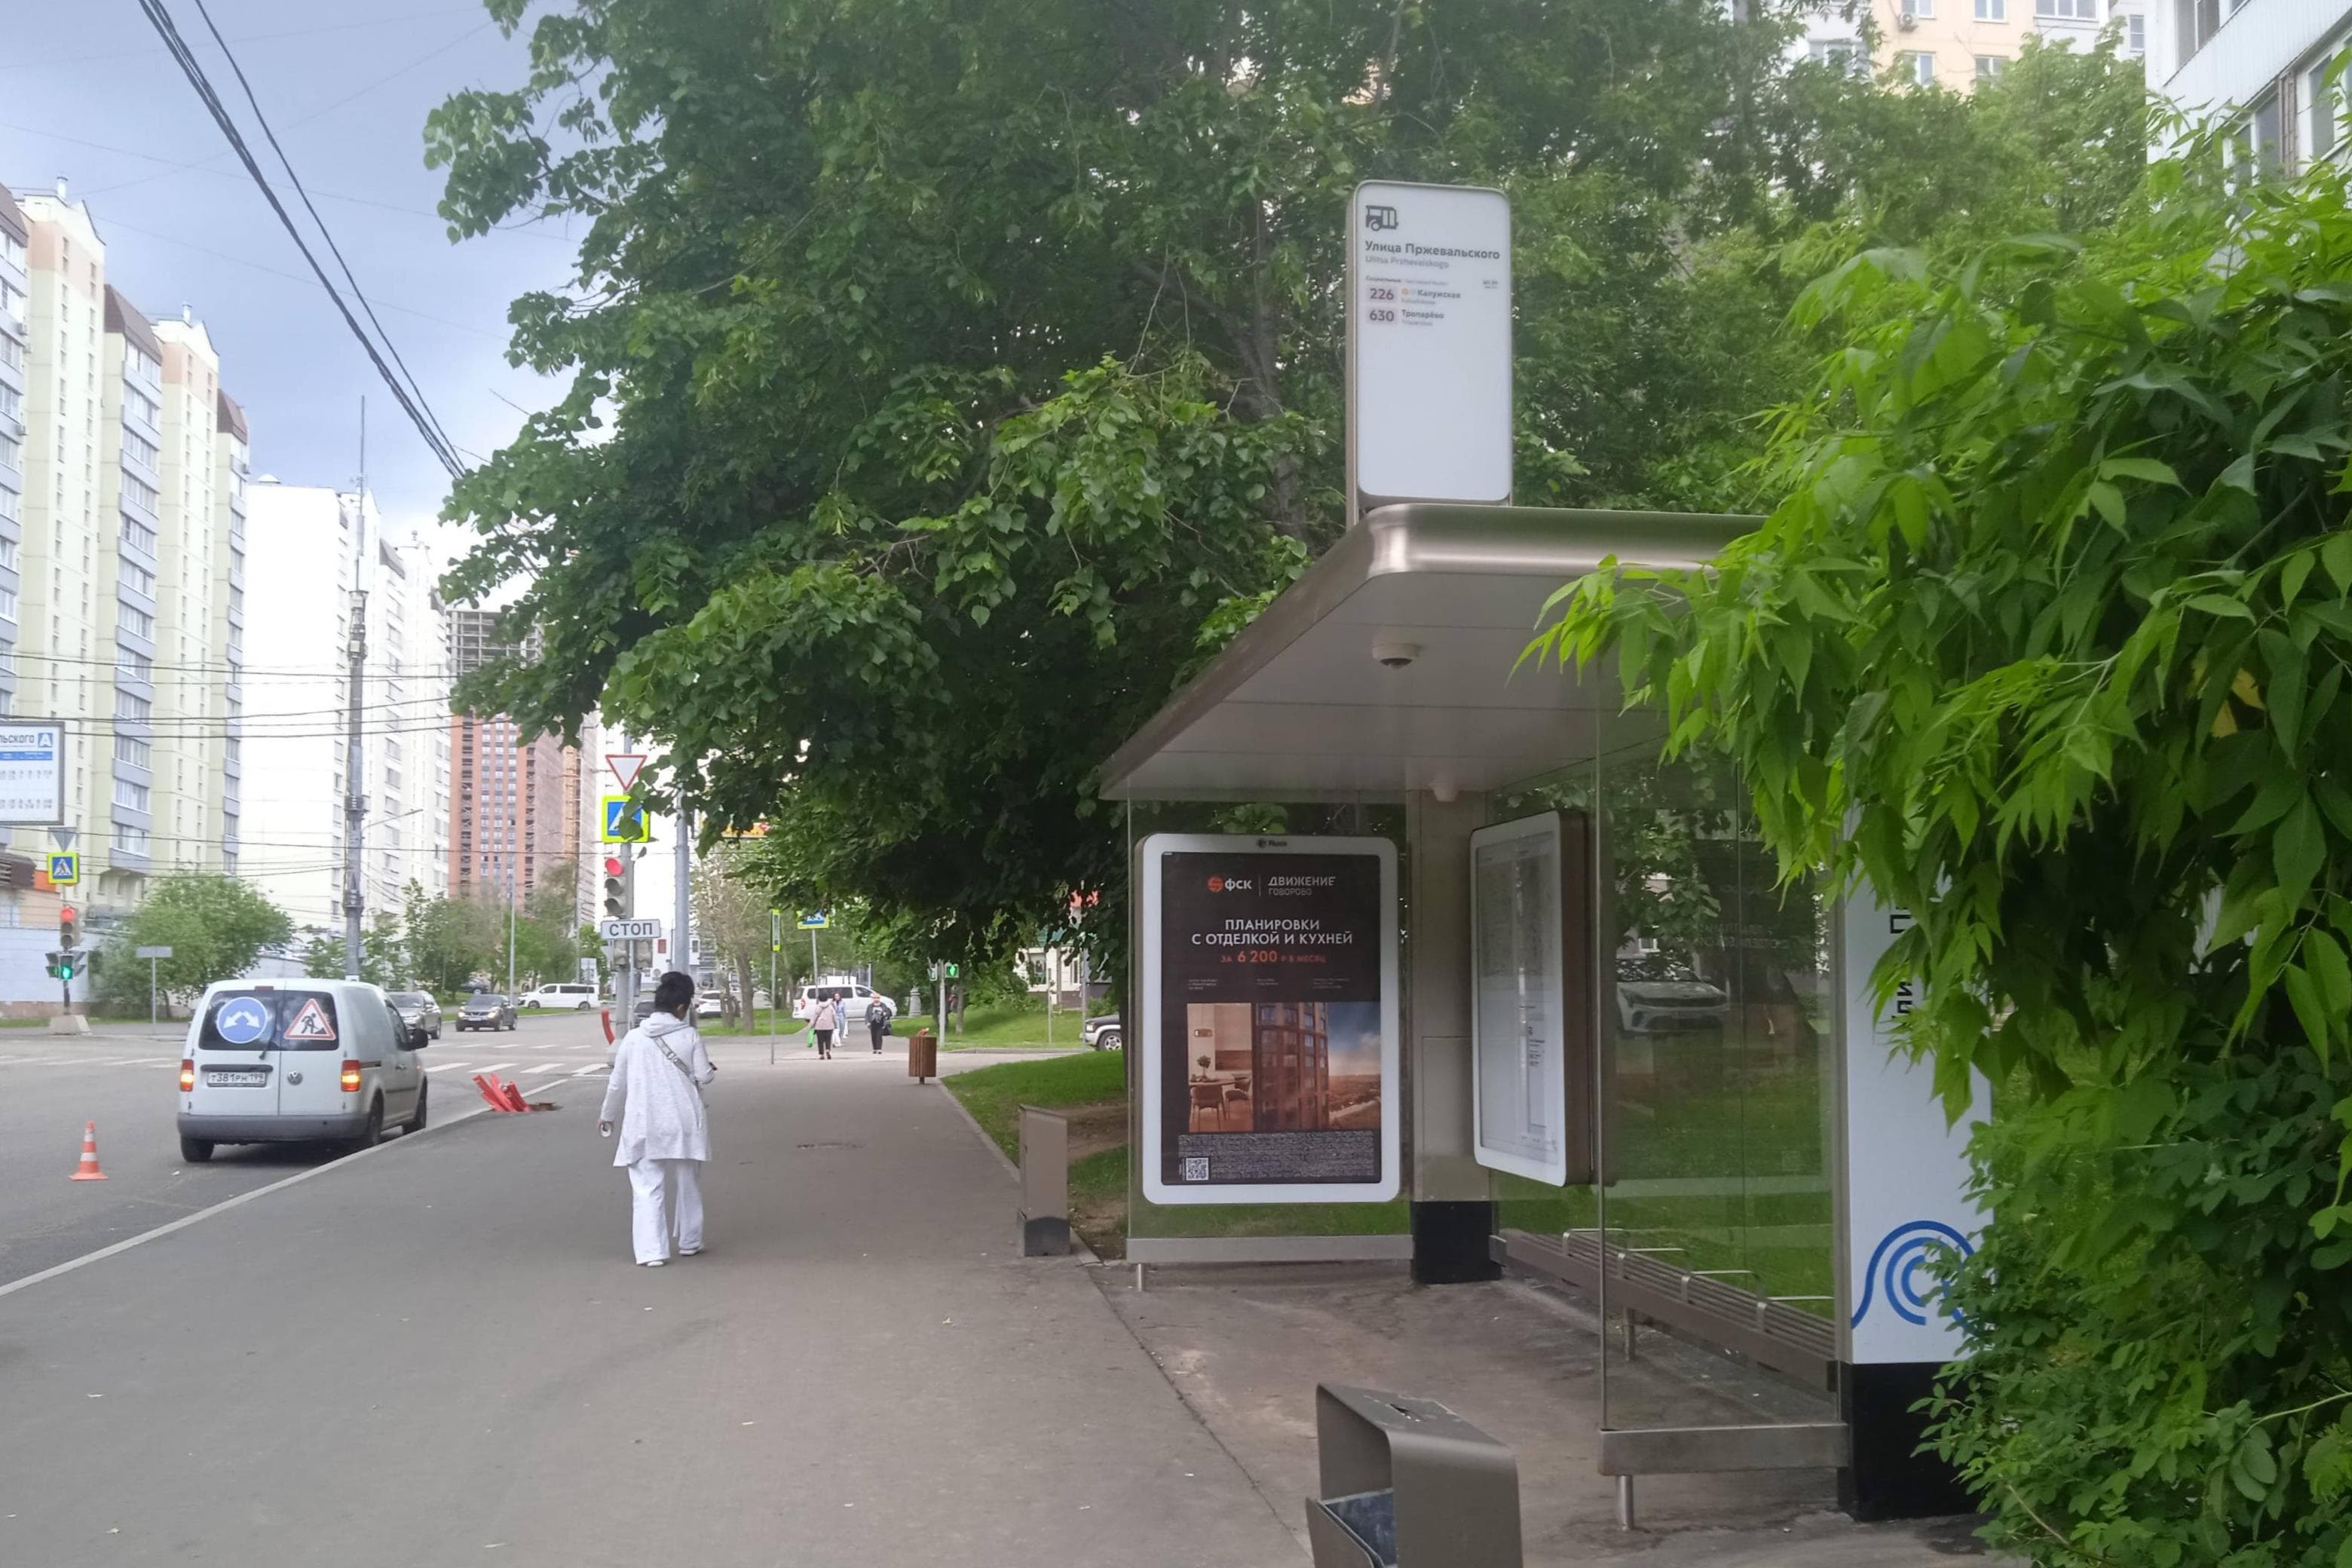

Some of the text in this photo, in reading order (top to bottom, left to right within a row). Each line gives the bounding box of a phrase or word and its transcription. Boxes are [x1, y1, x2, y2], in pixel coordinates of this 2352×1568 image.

[1364, 240, 1500, 259] Улица Пржевальского
[1369, 287, 1395, 301] 226
[1369, 309, 1395, 322] 630
[1267, 876, 1337, 887] ДВИЖЕНИЕ
[1268, 887, 1312, 896] ГОВОРОВО
[609, 923, 653, 936] СТОП
[1225, 919, 1320, 931] ПЛАНИРОВКИ
[1191, 930, 1353, 947] С ОТДЕЛКОЙ И КУХНЕЙ
[1237, 950, 1246, 963] 6
[1250, 950, 1278, 963] 200
